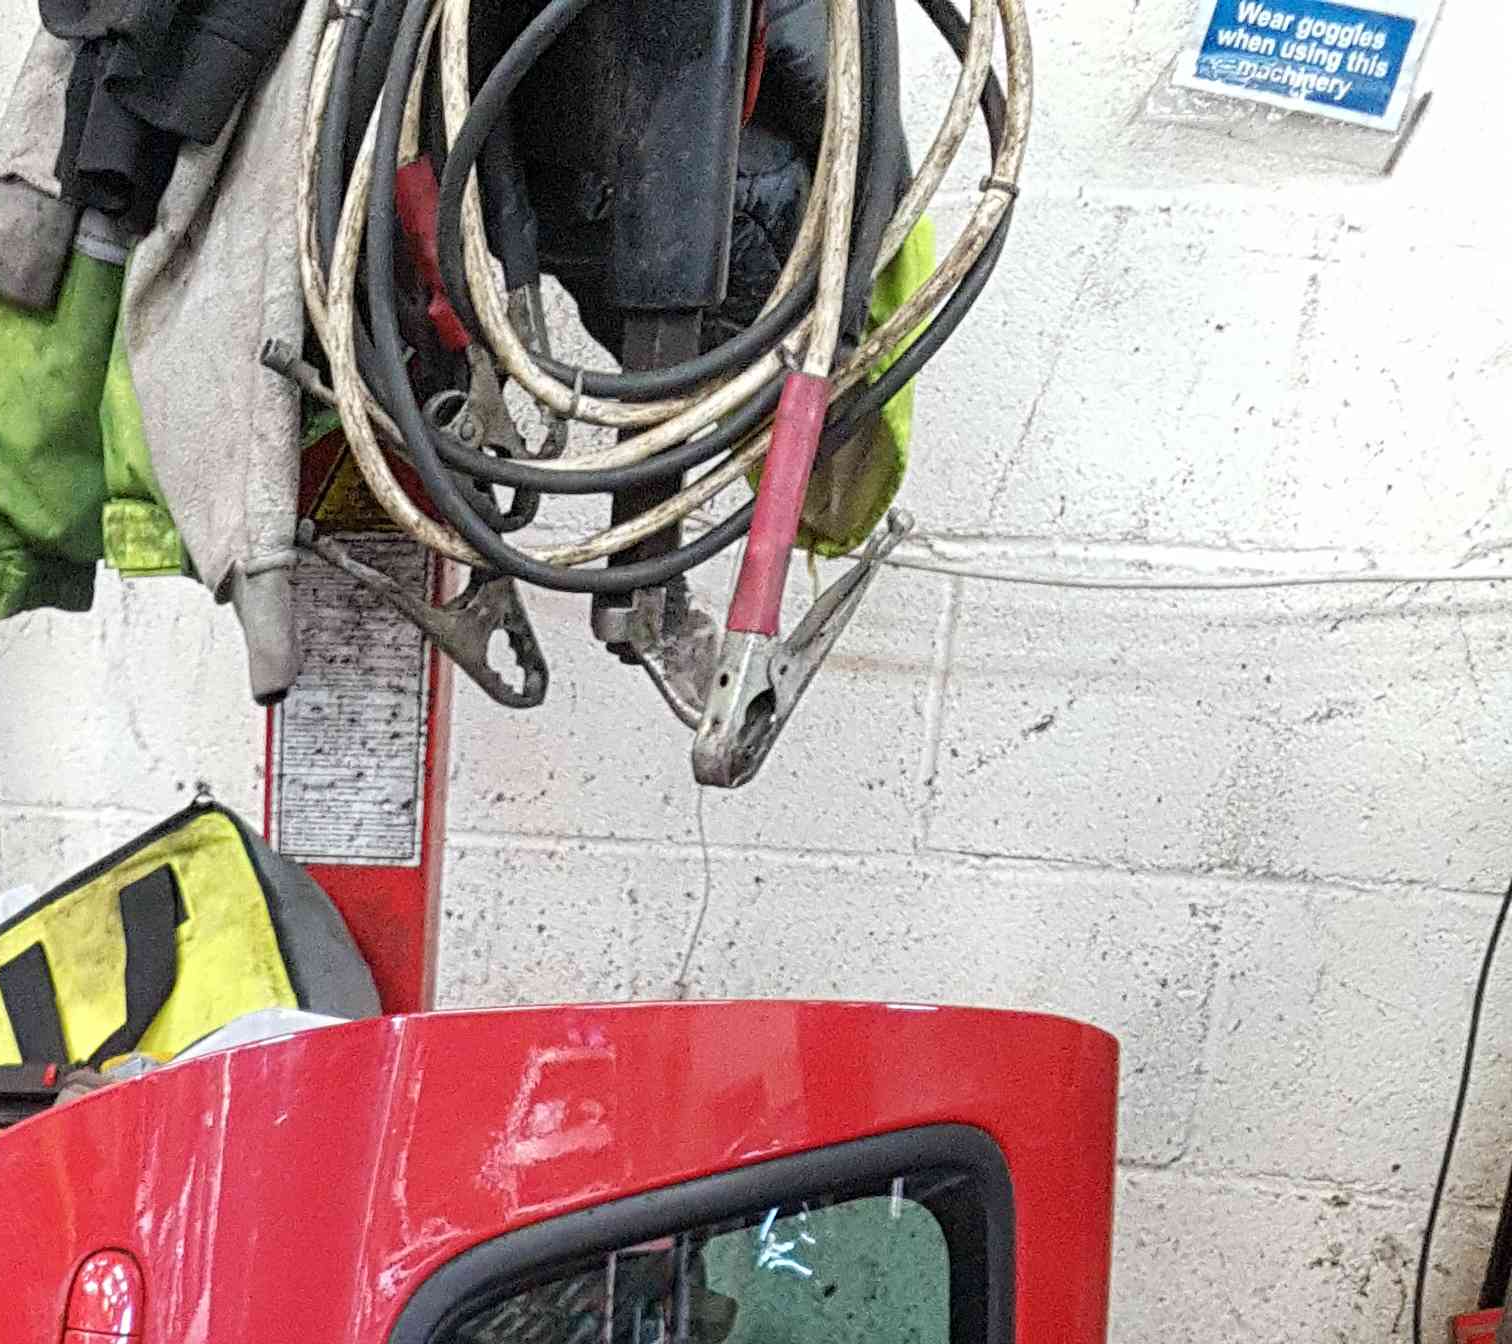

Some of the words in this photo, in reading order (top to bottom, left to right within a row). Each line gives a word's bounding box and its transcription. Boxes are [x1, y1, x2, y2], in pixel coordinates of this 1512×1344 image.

[1237, 1, 1296, 33] Wear
[1296, 15, 1387, 50] goggles
[1217, 27, 1276, 57] when
[1279, 40, 1344, 73] using
[1346, 51, 1389, 78] this
[1238, 58, 1352, 101] machinery
